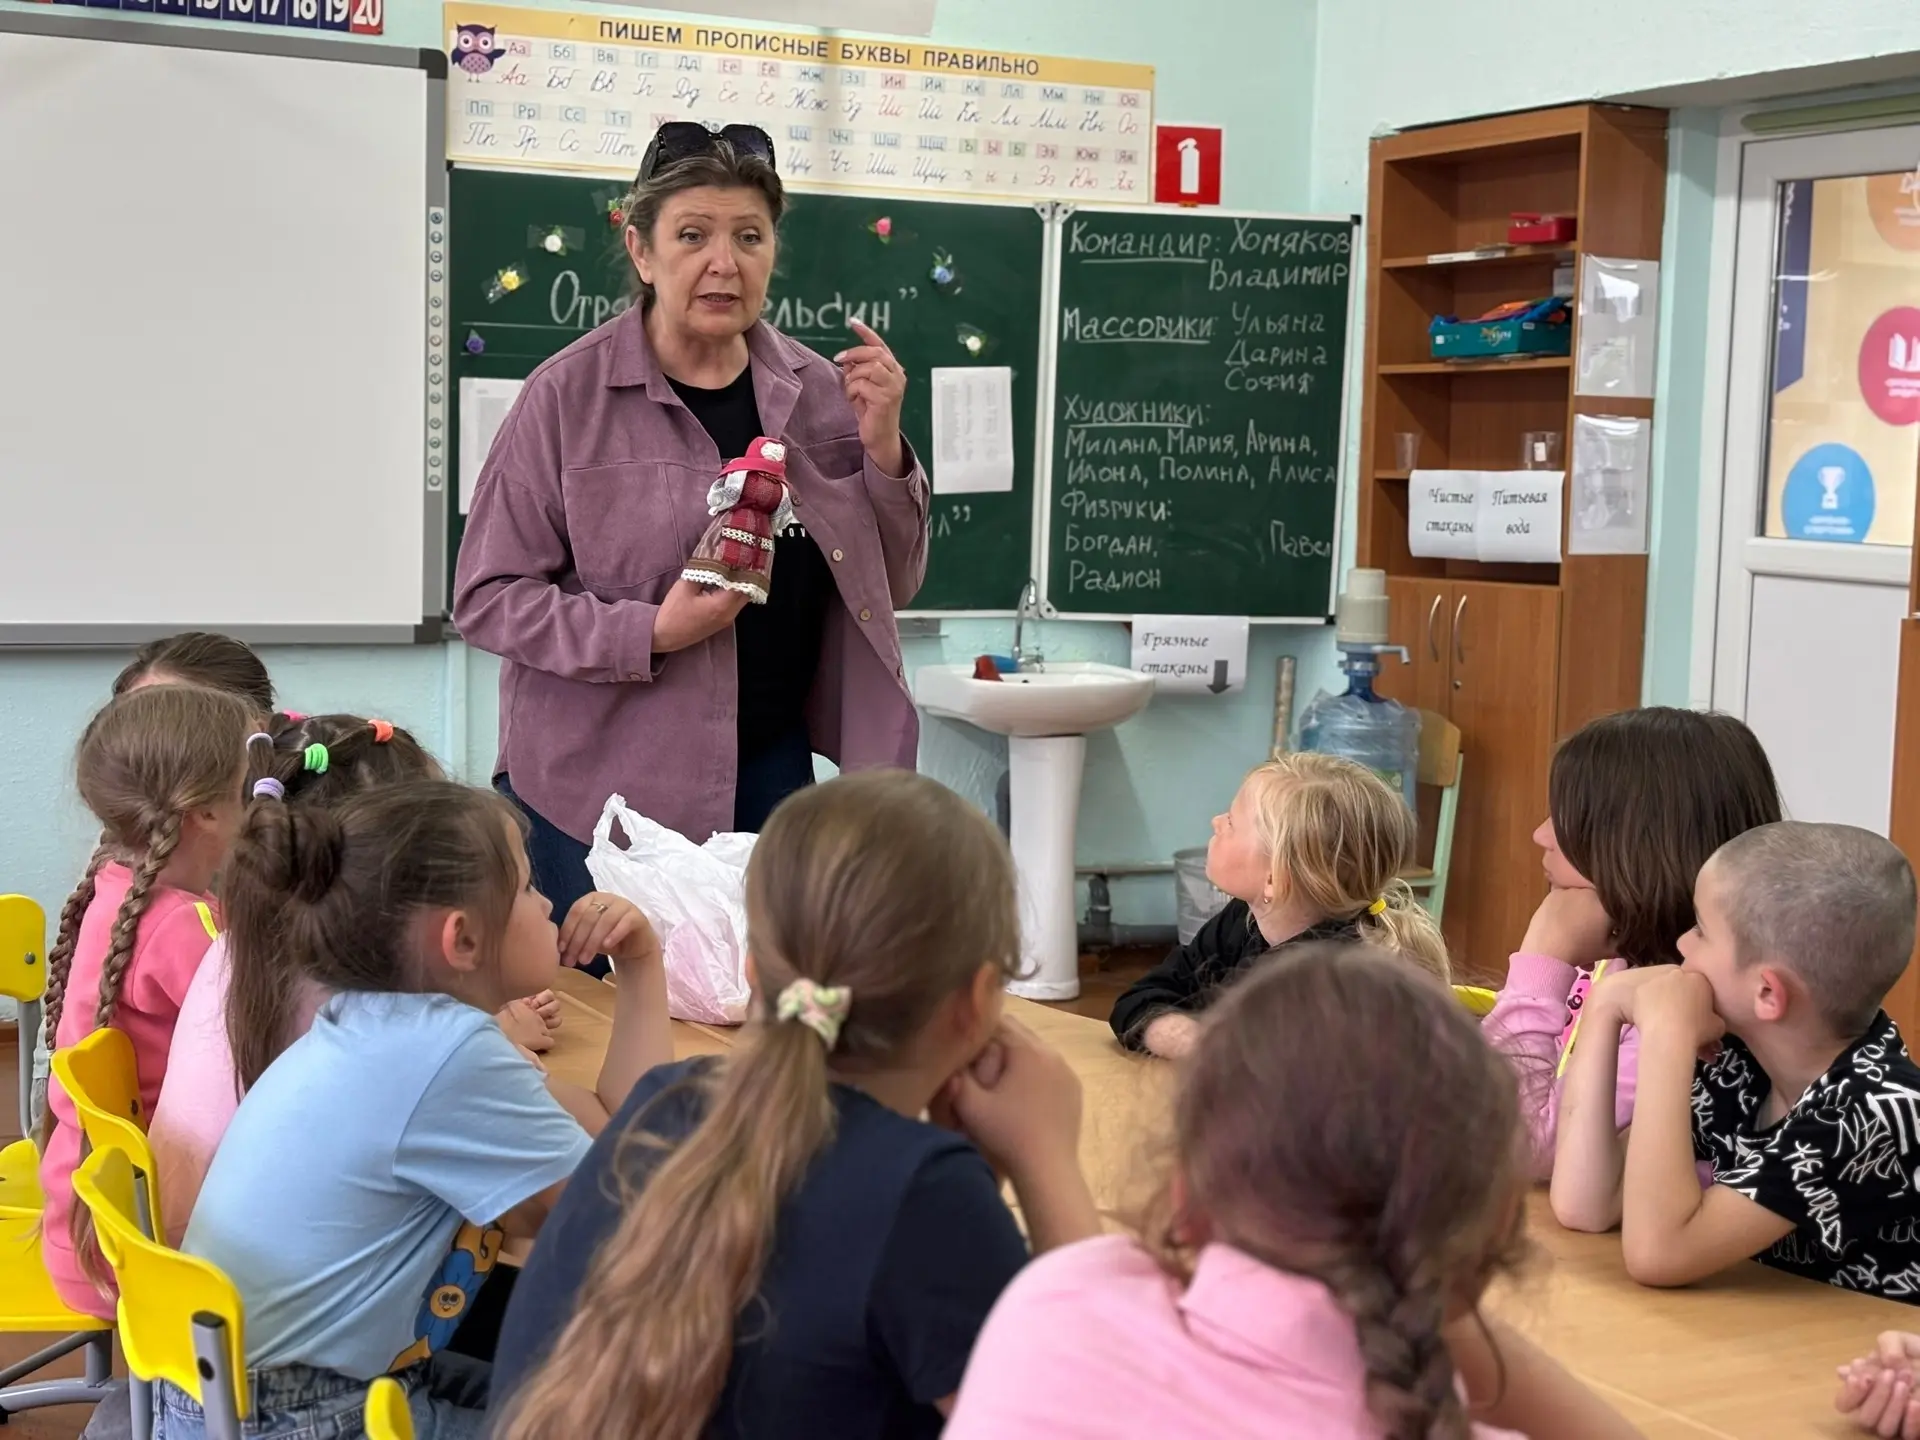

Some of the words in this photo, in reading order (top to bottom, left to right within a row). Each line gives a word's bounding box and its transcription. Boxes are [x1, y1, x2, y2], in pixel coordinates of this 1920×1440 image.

[352, 0, 382, 27] 20
[600, 21, 682, 44] ПИШЕМ
[696, 29, 829, 57] ПРОПИСНЫЕ
[841, 43, 911, 65] БУКВЫ
[923, 50, 1040, 76] ПРАВИЛЬНО
[1069, 220, 1220, 259] Командир:
[1229, 217, 1351, 258] Хомяков
[1208, 257, 1349, 292] Владимир
[1232, 300, 1326, 336] Ульяна
[1224, 338, 1328, 368] Дарина
[1225, 366, 1315, 395] София
[1268, 454, 1337, 484] Алиса
[1060, 487, 1172, 522] Физруки:
[1429, 488, 1474, 504] Чистые
[1492, 489, 1548, 506] Питьевая
[1426, 520, 1474, 536] стаканы
[1505, 517, 1530, 535] вода
[1068, 559, 1161, 594] Радион
[1142, 632, 1210, 650] Грязные
[1140, 661, 1208, 678] стаканы
